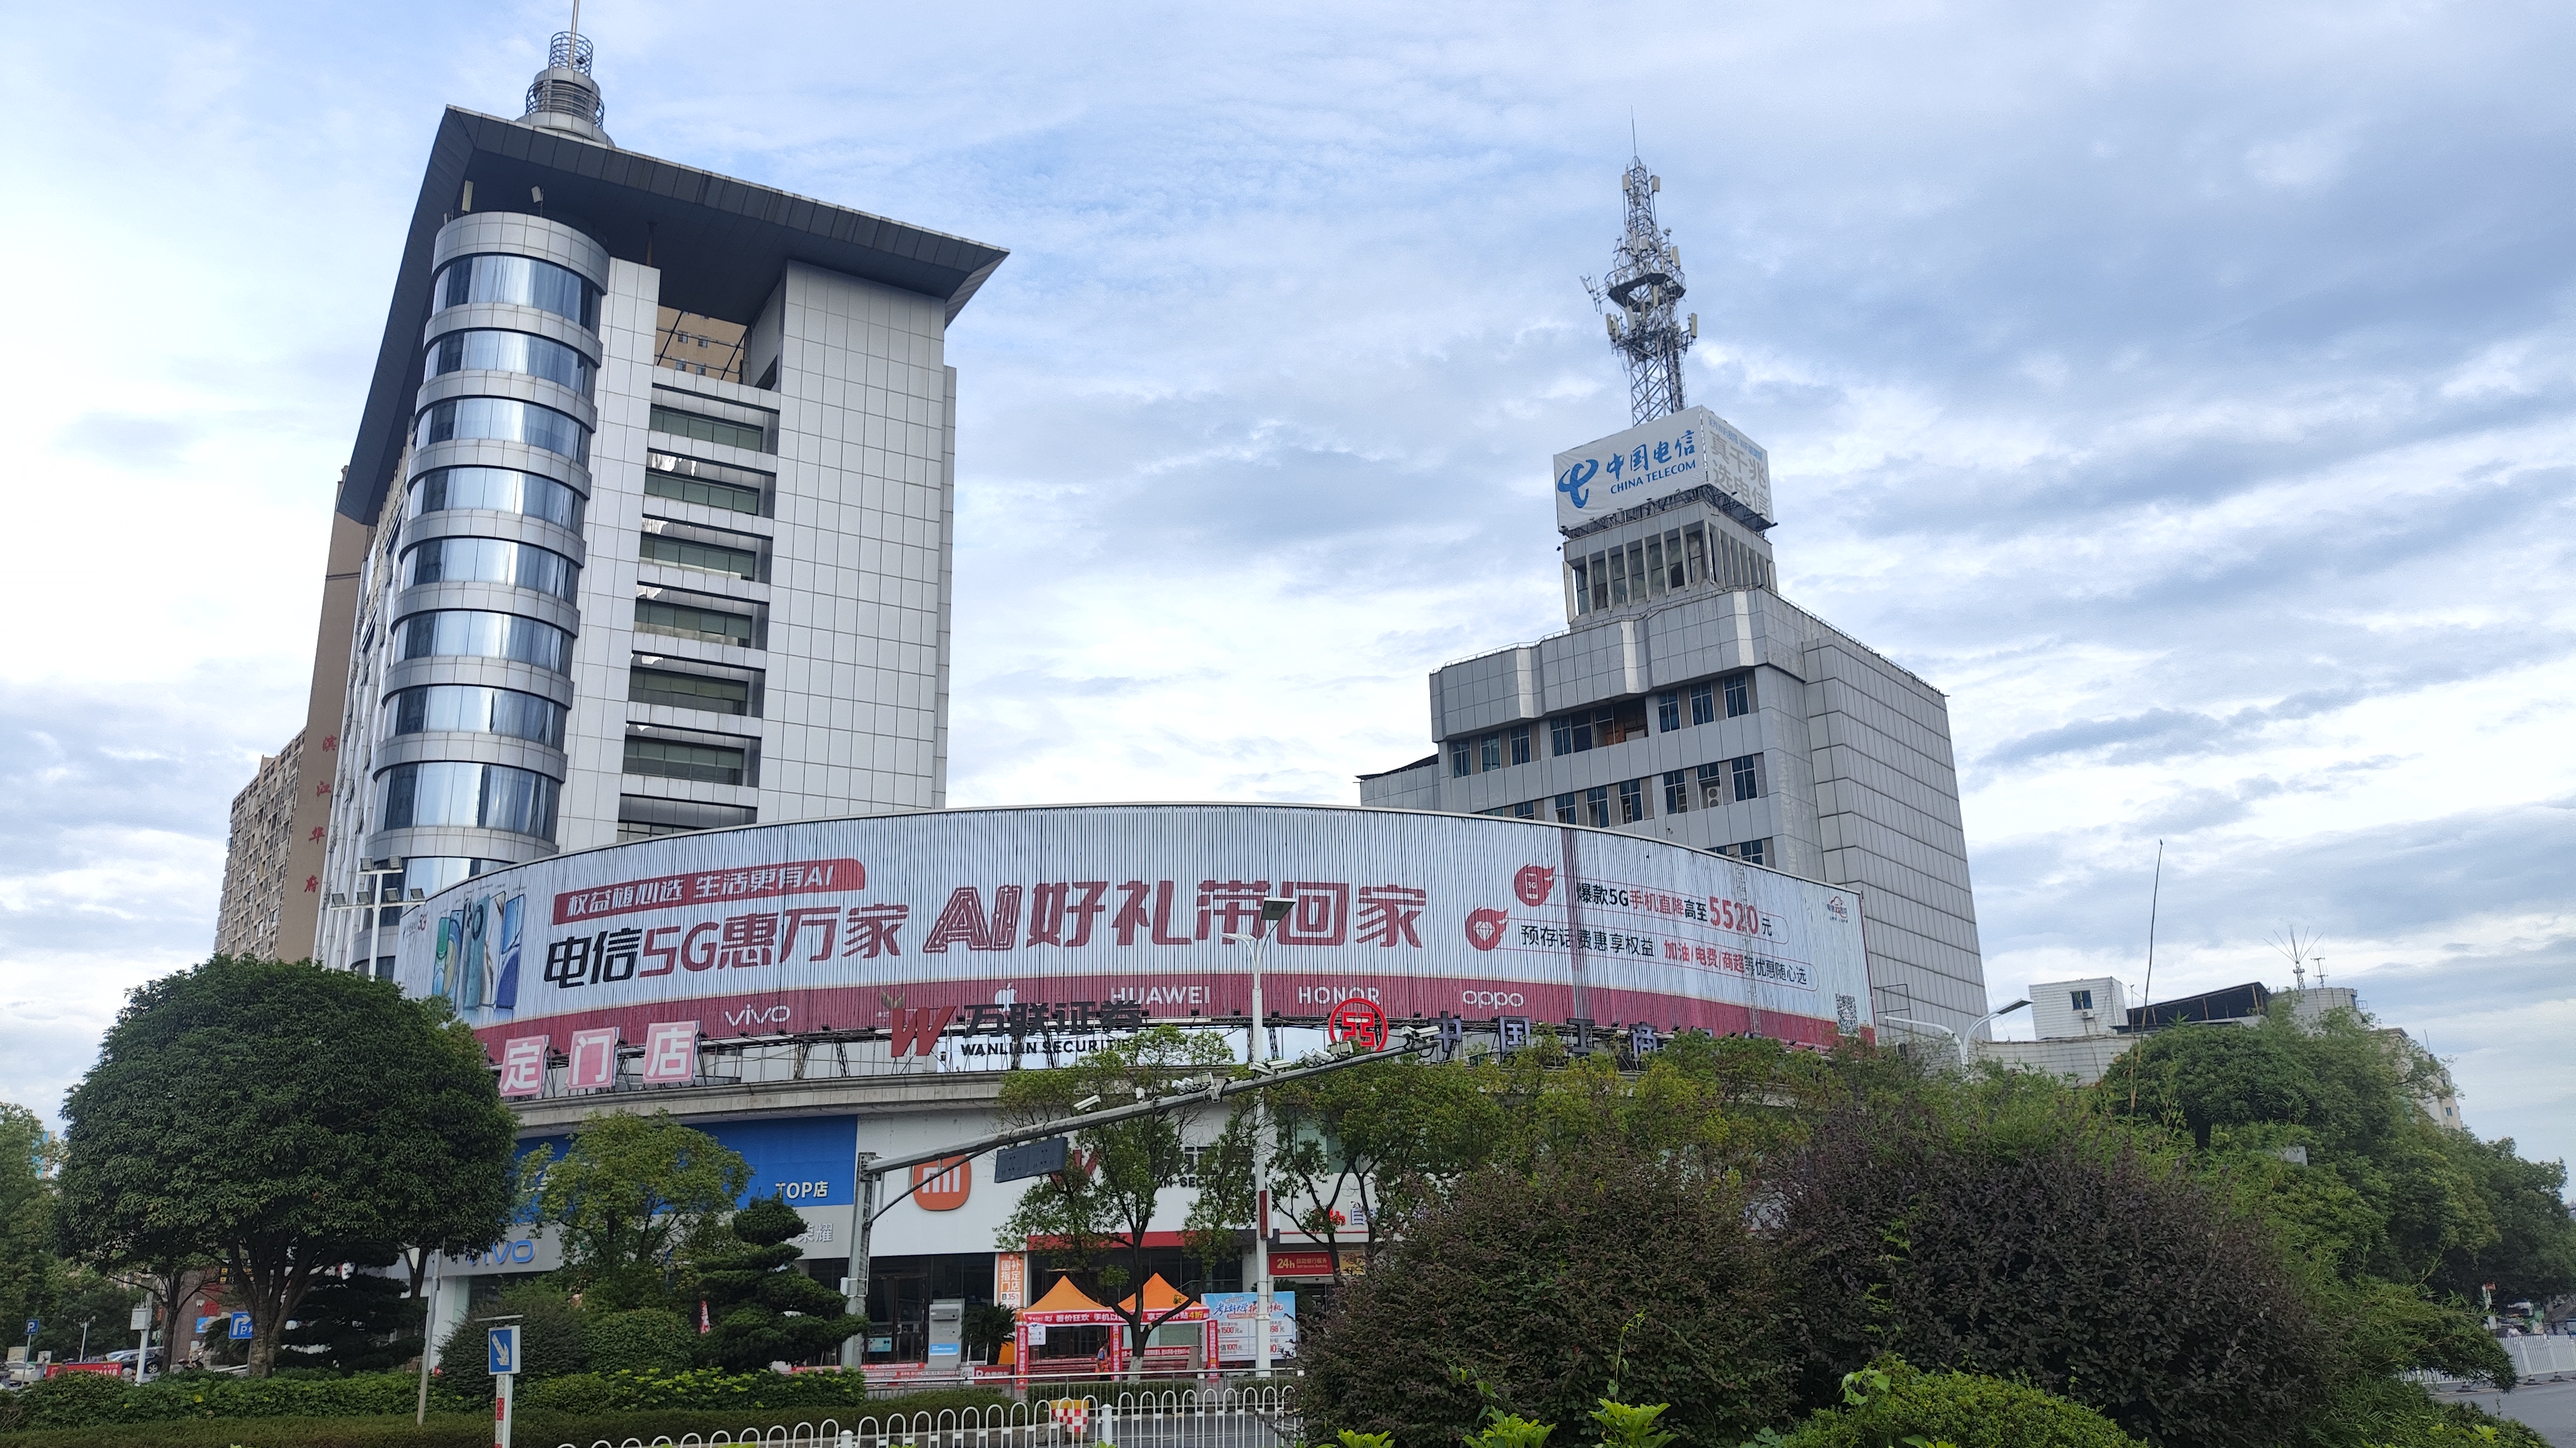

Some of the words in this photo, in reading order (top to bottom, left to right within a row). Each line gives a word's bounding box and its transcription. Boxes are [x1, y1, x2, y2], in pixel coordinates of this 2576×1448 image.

[1607, 429, 1695, 481] 中国电信
[1710, 431, 1767, 489] 真千兆
[1611, 476, 1643, 494] CHINA
[1646, 459, 1695, 483] TELECOM
[1713, 459, 1769, 518] 选电信
[304, 734, 337, 893] 滨江华府
[567, 879, 684, 918] 权益随心选
[694, 864, 834, 899] 生活更有AI
[923, 880, 1426, 954] AI好礼带回家
[544, 903, 910, 988] 电信5G惠万家
[1521, 925, 1655, 957] 预存话费惠享权益
[1111, 986, 1210, 1005] HUAWEI
[1298, 986, 1380, 1005] HONOR
[725, 1004, 791, 1026] vivo
[963, 1000, 1143, 1038] 万联证券
[502, 1028, 692, 1092] 定门店
[960, 1043, 1037, 1056] WANLIAN
[775, 1181, 828, 1199] TOP店
[1001, 1270, 1021, 1281] 指定
[1277, 1258, 1295, 1269] 24h
[1001, 1281, 1021, 1292] 门店
[27, 1322, 35, 1332] P
